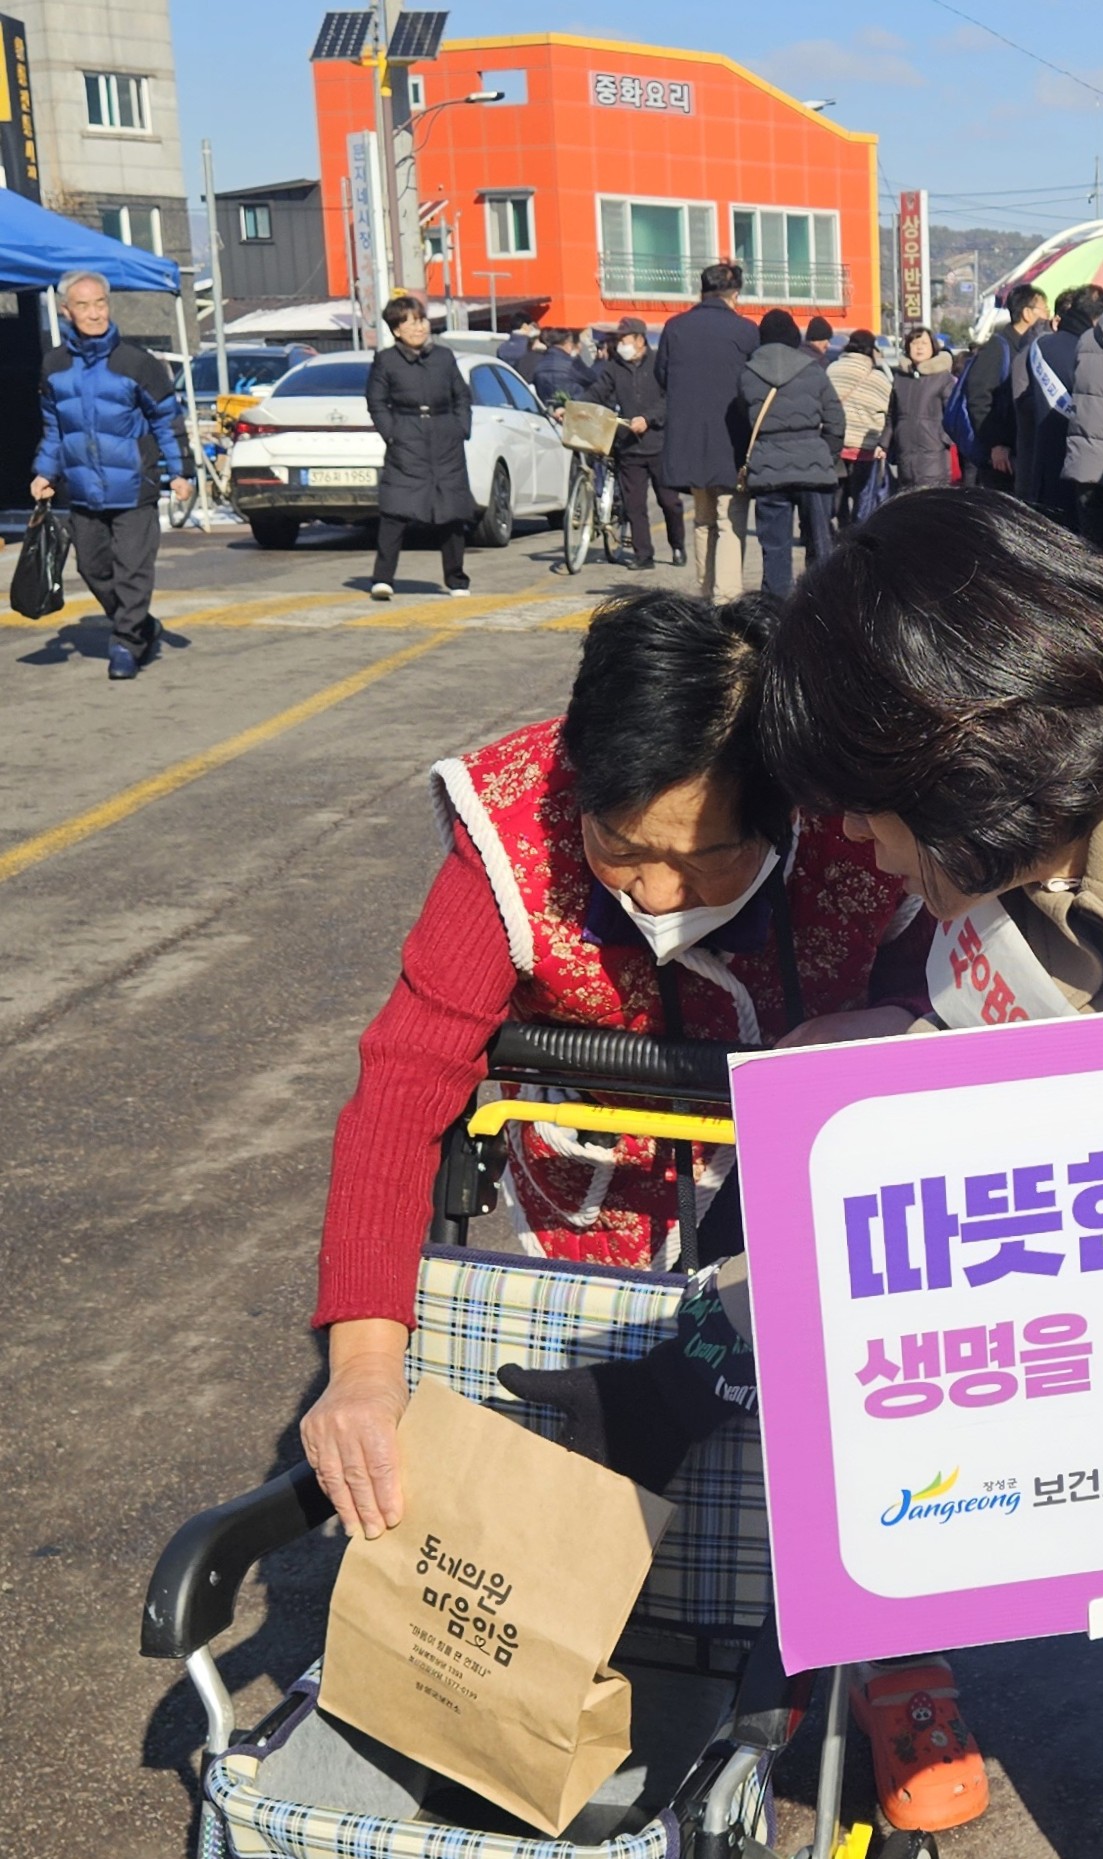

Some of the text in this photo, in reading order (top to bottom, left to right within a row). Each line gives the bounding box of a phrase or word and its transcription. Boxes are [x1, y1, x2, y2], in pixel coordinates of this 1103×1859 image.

[595, 73, 690, 114] 중화요리
[902, 214, 922, 318] 상우반점
[855, 1313, 1094, 1420] 생명을
[880, 1489, 1021, 1527] Jangseong
[983, 1477, 1018, 1492] 장성군
[416, 1533, 513, 1616] 동네의원
[422, 1586, 519, 1668] 마음이음
